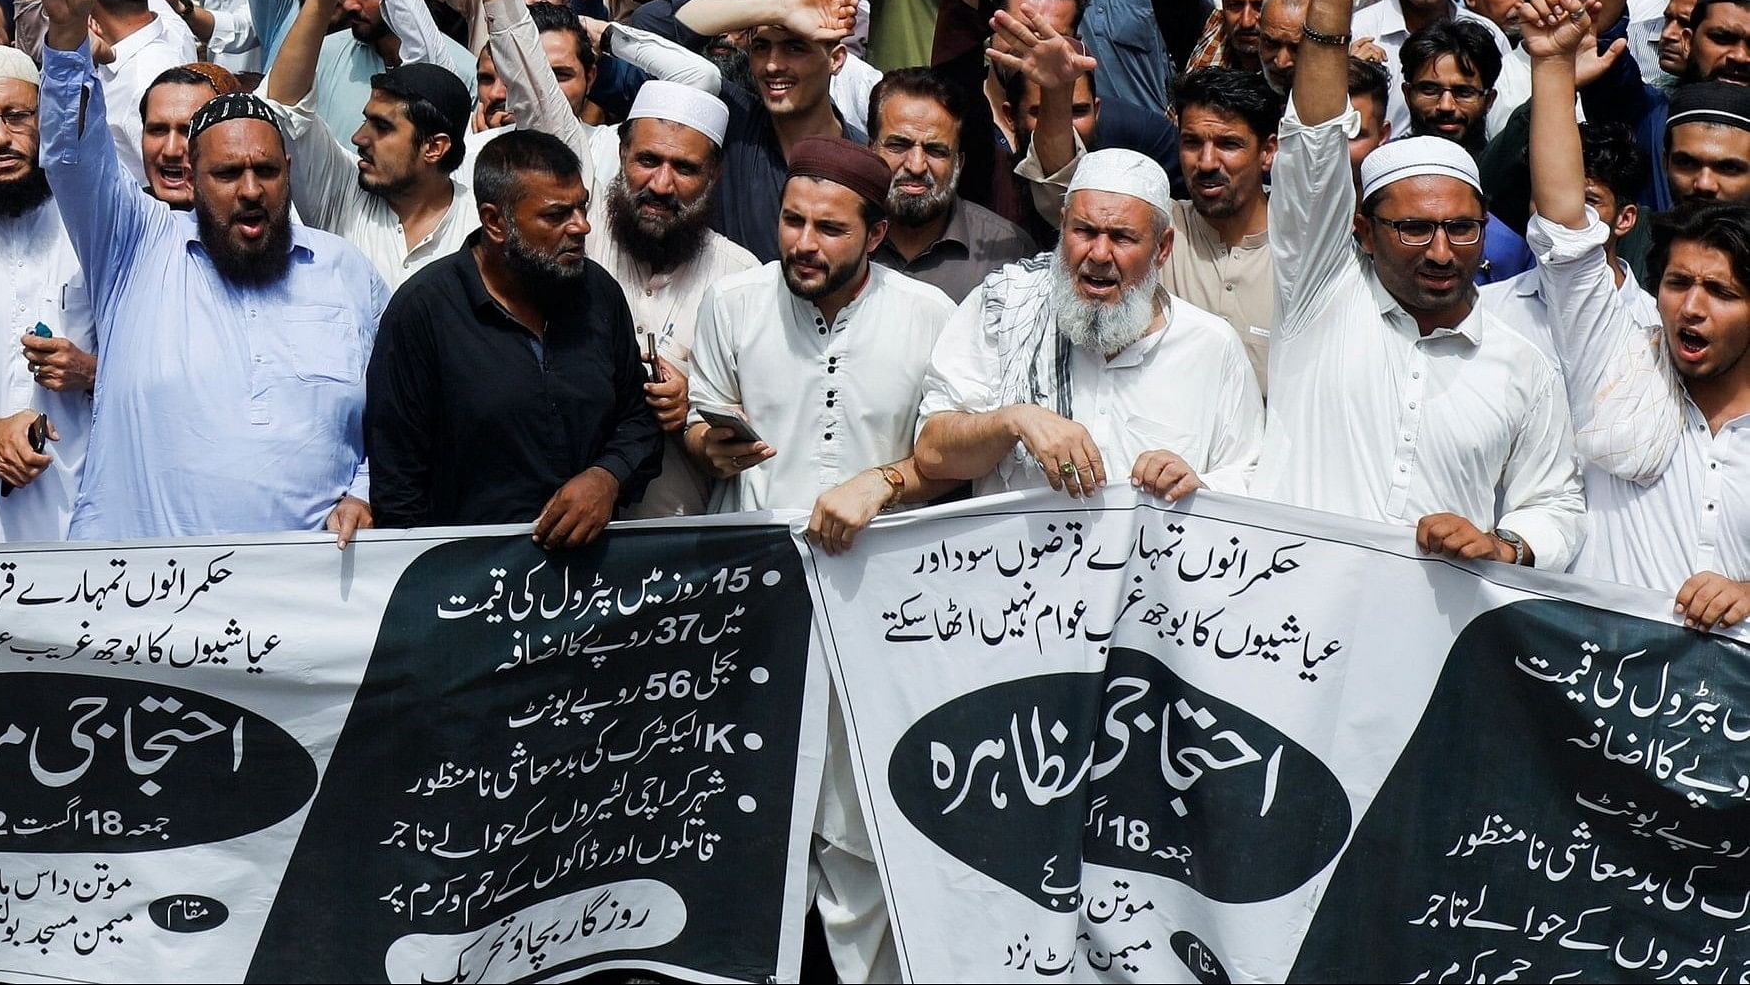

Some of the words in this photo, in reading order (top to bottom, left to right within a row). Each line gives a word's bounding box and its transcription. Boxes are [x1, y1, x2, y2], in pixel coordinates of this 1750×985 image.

[995, 521, 1084, 578] قرضوں
[1086, 523, 1183, 571] تمہارے
[1176, 537, 1307, 597] حکمرانوں
[16, 560, 126, 611] تمہارے
[126, 551, 235, 614] حکمرانوں
[437, 568, 508, 623] قیمت
[508, 560, 547, 621] کی
[540, 566, 613, 621] پٹرول
[617, 566, 664, 616] میں
[666, 572, 708, 604] روز
[712, 566, 752, 595] 15
[655, 614, 701, 644] 37
[698, 605, 746, 644] میں
[882, 594, 934, 643] سکتے
[934, 596, 976, 641] اٹھا
[981, 582, 1037, 645] نہیں
[1036, 597, 1088, 654] عوام
[1138, 602, 1186, 647] بوجھ
[1193, 608, 1226, 647] کا
[9, 621, 94, 664] غریب
[93, 630, 143, 667] بوجھ
[148, 624, 173, 666] کا
[169, 618, 282, 674] عیاشیوں
[496, 630, 568, 672] اضافہ
[567, 624, 595, 657] کا
[582, 627, 653, 668] روپے
[1214, 614, 1342, 683] عیاشیوں
[644, 669, 692, 700] 56
[694, 648, 741, 700] بجلی
[1514, 640, 1600, 703] قیمت
[1592, 649, 1647, 708] کی
[508, 689, 572, 728] یونٹ
[570, 685, 641, 725] روپے
[1629, 661, 1722, 734] پٹرول
[29, 696, 244, 797] احتجاجی
[583, 718, 618, 773] کی
[608, 709, 702, 764] الیکٹرک
[1566, 718, 1656, 770] اضافہ
[1655, 737, 1691, 780] کا
[551, 771, 629, 834] لٹیروں
[624, 765, 710, 820] کراچی
[678, 769, 726, 817] شہر
[1575, 792, 1658, 838] یونٹ
[12, 796, 80, 835] اگست
[85, 810, 122, 836] 18
[126, 815, 171, 841] جمعہ
[380, 820, 436, 853] تاجر
[511, 796, 548, 847] کے
[1108, 815, 1151, 852] 18
[430, 822, 516, 859] حوالے
[600, 835, 636, 866] اور
[636, 818, 722, 865] قاتلوں
[1151, 845, 1192, 876] جمعہ
[14, 870, 70, 900] داس
[73, 863, 132, 903] موتن
[379, 882, 405, 914] پر
[464, 870, 496, 927] رحم
[494, 854, 531, 903] کے
[1662, 865, 1718, 911] کی
[167, 899, 209, 928] مقام
[561, 890, 650, 944] روزگار
[1086, 880, 1155, 924] موتن
[1408, 890, 1468, 928] تاجر
[1462, 884, 1567, 941] حوالے
[29, 915, 78, 955] مسجد
[74, 912, 133, 956] میمن
[507, 919, 562, 971] بچاؤ
[1558, 906, 1612, 950] کے
[1004, 933, 1032, 970] نزد
[1087, 939, 1153, 973] میمن
